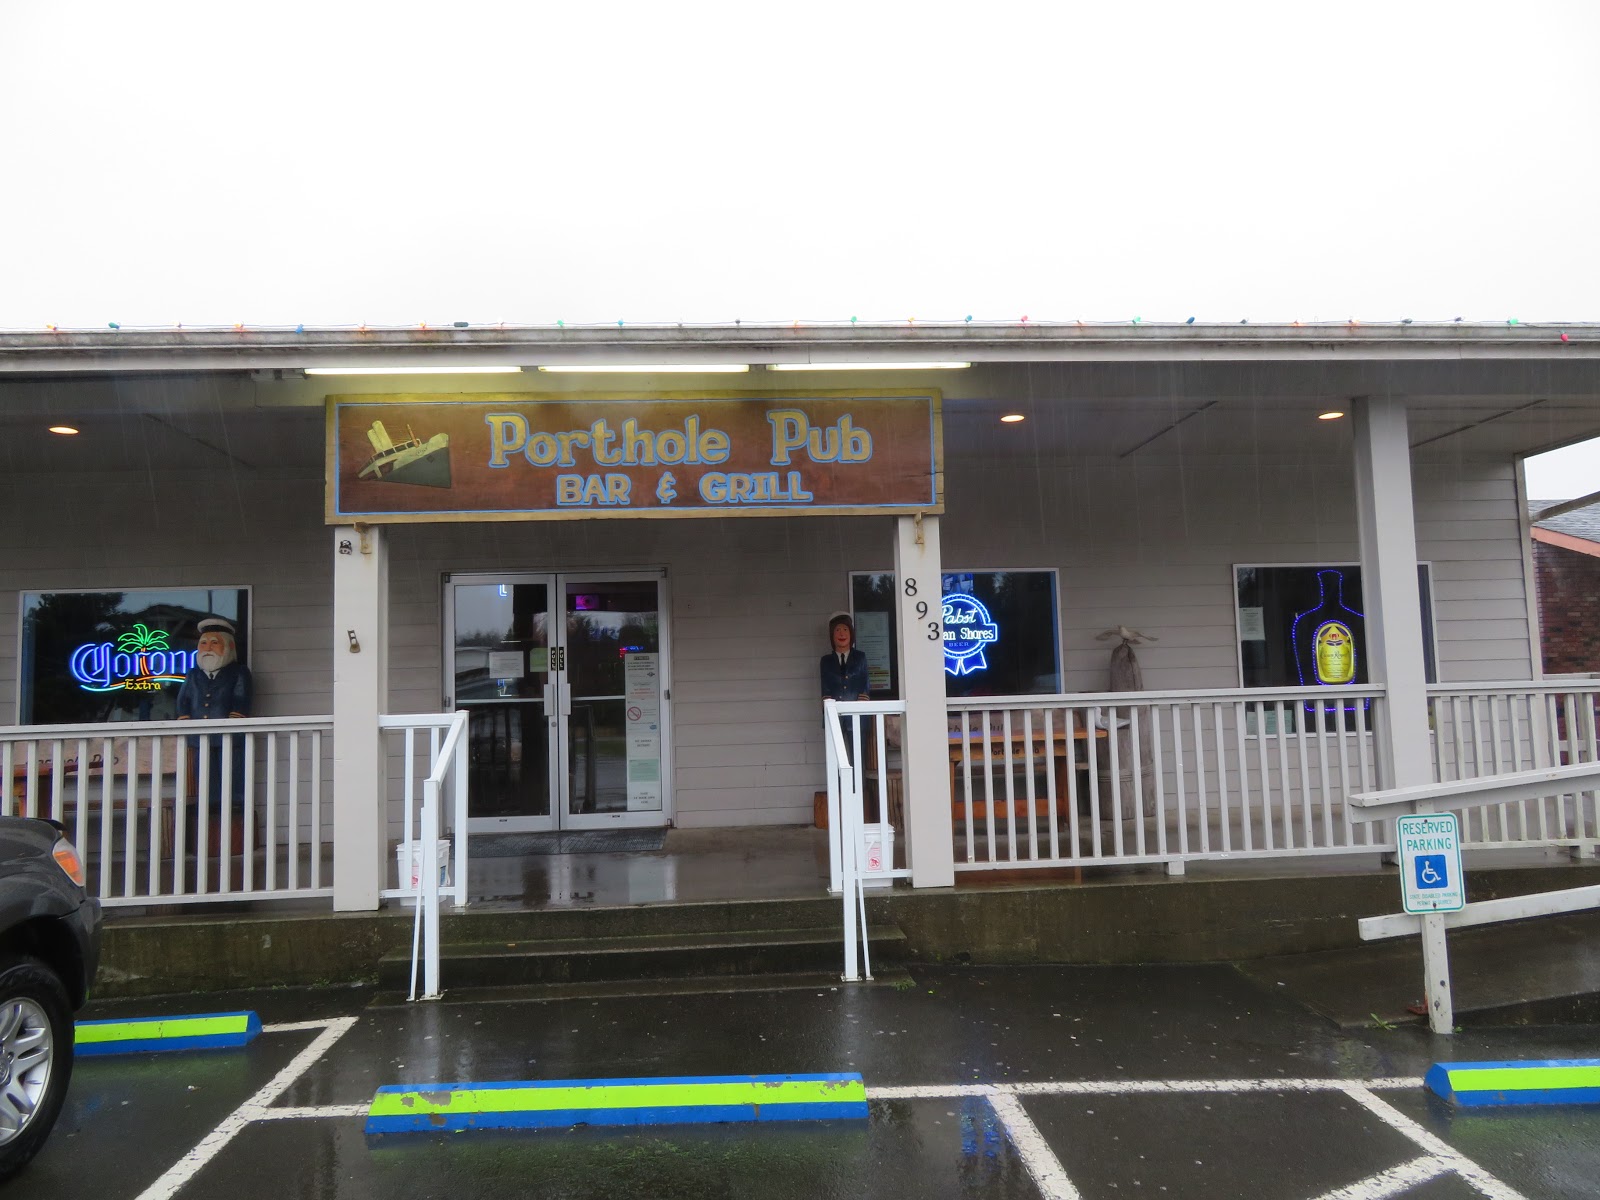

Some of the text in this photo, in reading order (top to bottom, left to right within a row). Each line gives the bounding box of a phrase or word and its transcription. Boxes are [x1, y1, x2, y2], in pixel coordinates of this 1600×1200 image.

[485, 409, 873, 467] Porthole Pub
[557, 471, 813, 505] BAR & GRILL
[942, 605, 978, 624] Pabst
[960, 627, 994, 640] Shores
[125, 679, 161, 690] Extra
[1402, 821, 1453, 835] RESERVED
[1406, 837, 1452, 851] PARKING
